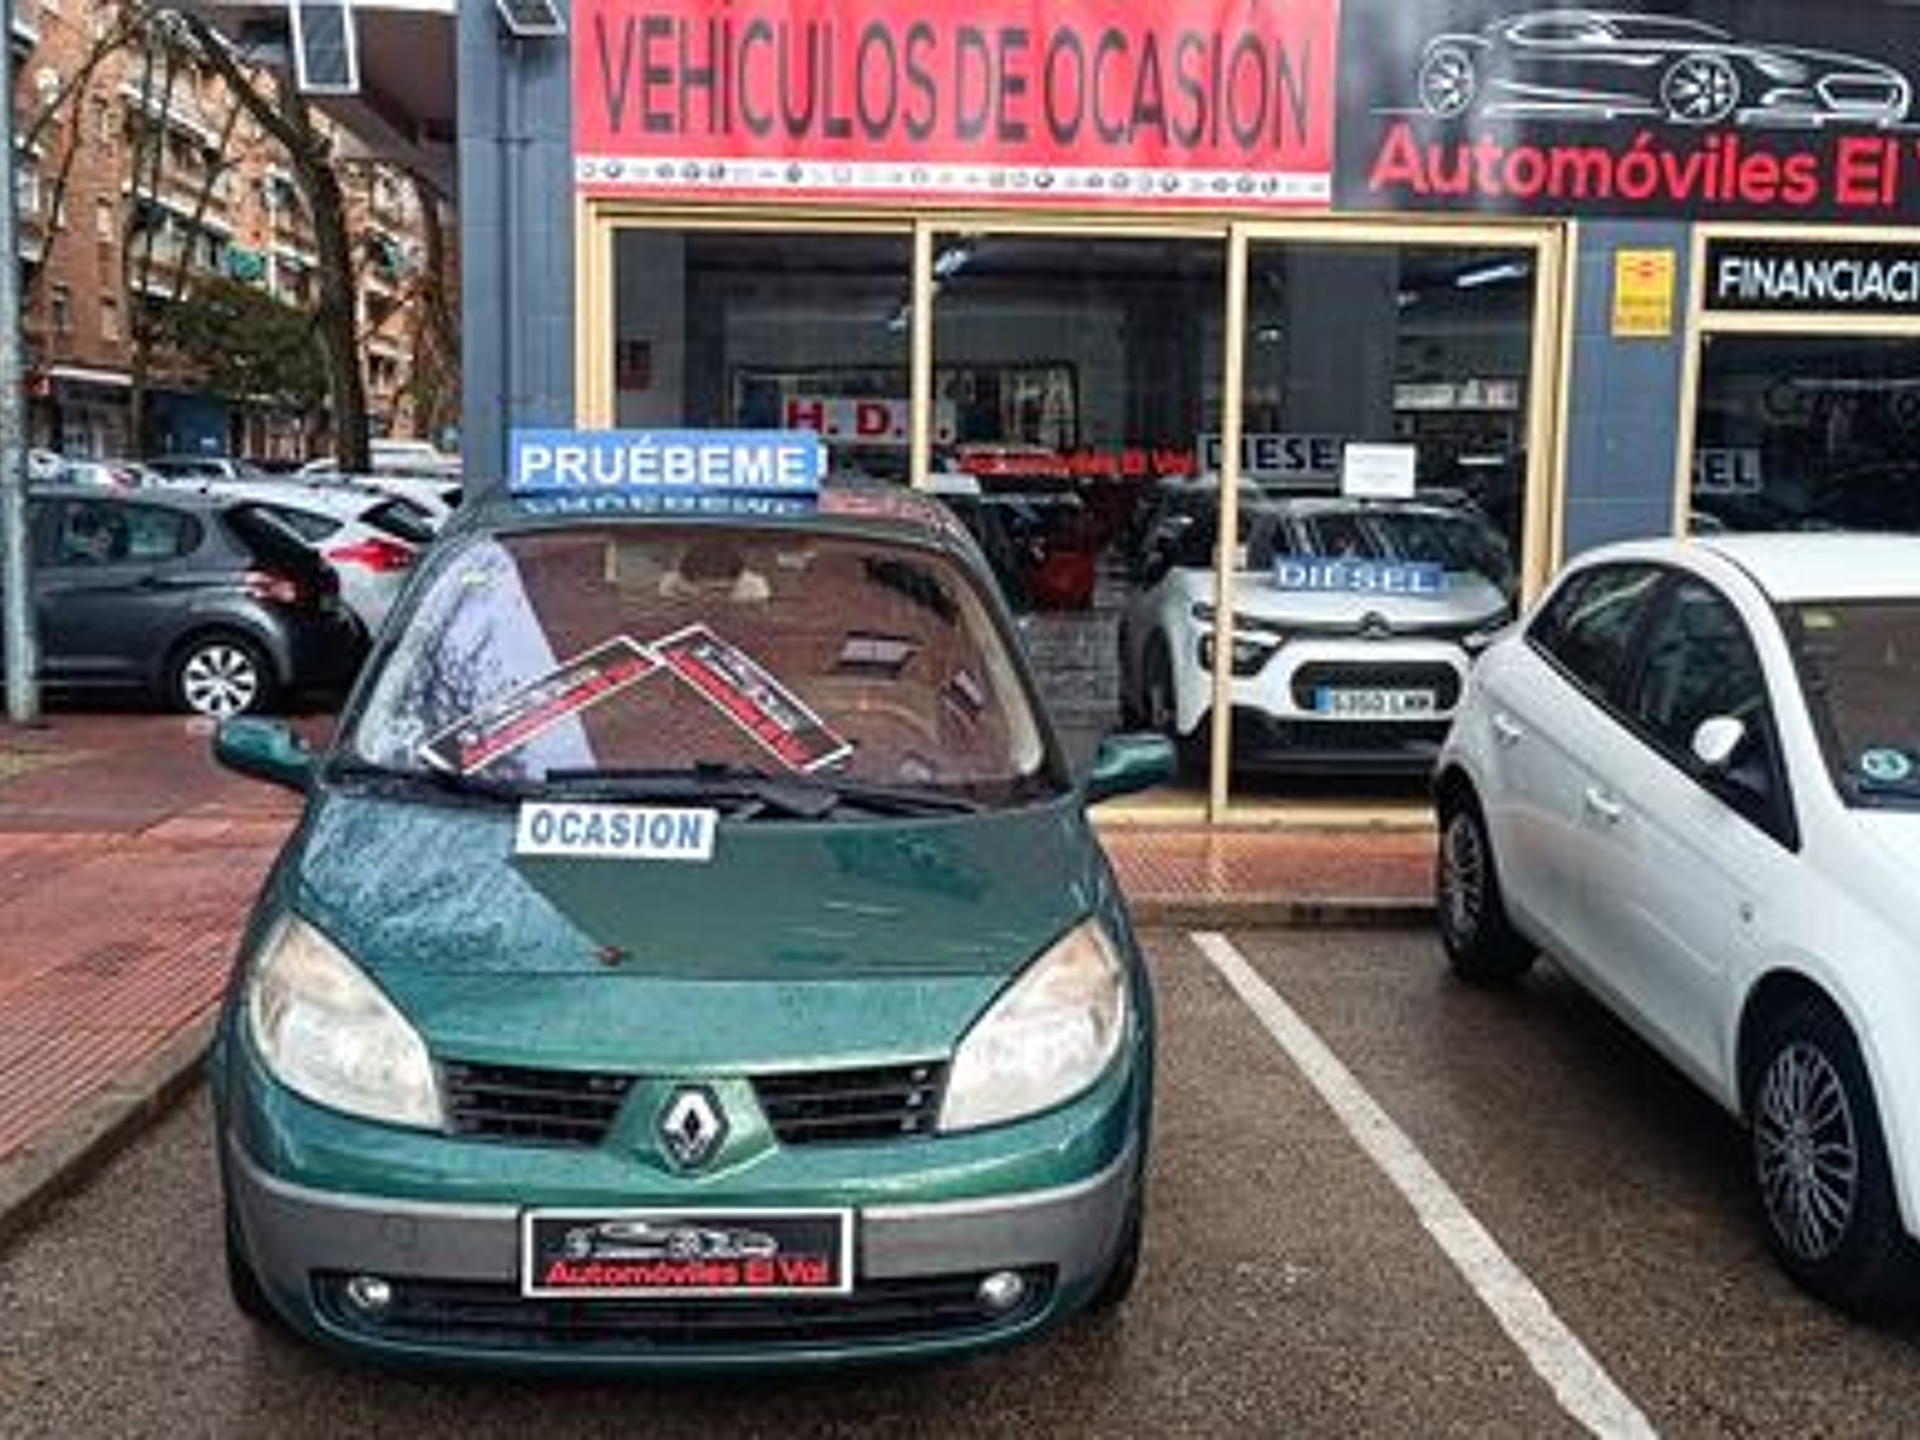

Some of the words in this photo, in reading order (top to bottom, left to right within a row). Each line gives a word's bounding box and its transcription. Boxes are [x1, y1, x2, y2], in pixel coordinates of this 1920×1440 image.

[594, 0, 938, 140] VEHÍCULOS
[954, 26, 1029, 144] DE
[1042, 0, 1310, 150] OCASIÓN
[1369, 123, 1818, 202] Automóviles
[1835, 136, 1897, 207] El
[520, 434, 806, 485] PRUÉBEME
[1279, 565, 1437, 593] DIESEL
[530, 808, 703, 849] OCASION
[546, 1258, 740, 1284] Automóviles
[746, 1259, 775, 1284] El
